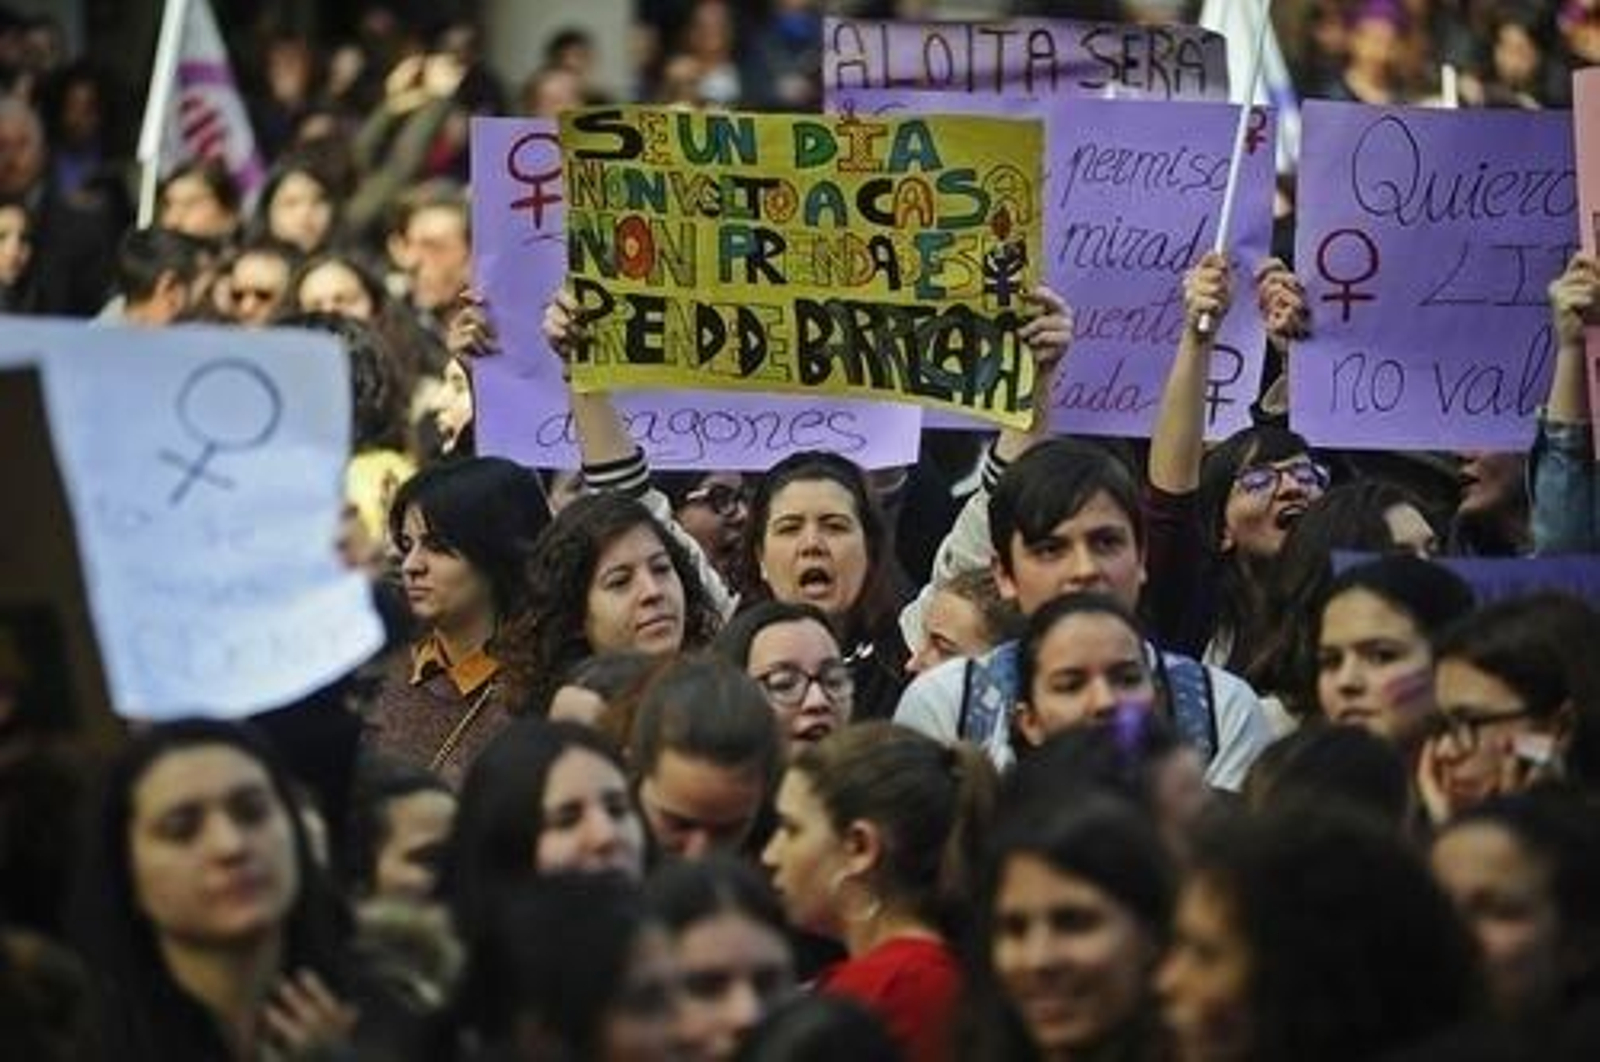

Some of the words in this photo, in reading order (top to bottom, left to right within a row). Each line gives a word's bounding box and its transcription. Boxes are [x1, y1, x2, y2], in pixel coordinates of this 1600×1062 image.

[572, 110, 675, 166] SE
[677, 112, 758, 167] UN
[568, 161, 667, 214] NON
[804, 180, 849, 228] A
[856, 165, 1033, 229] CASA
[1352, 115, 1578, 228] Quiero
[567, 209, 698, 288] NON
[1057, 213, 1210, 275] mirad
[1330, 351, 1405, 414] no
